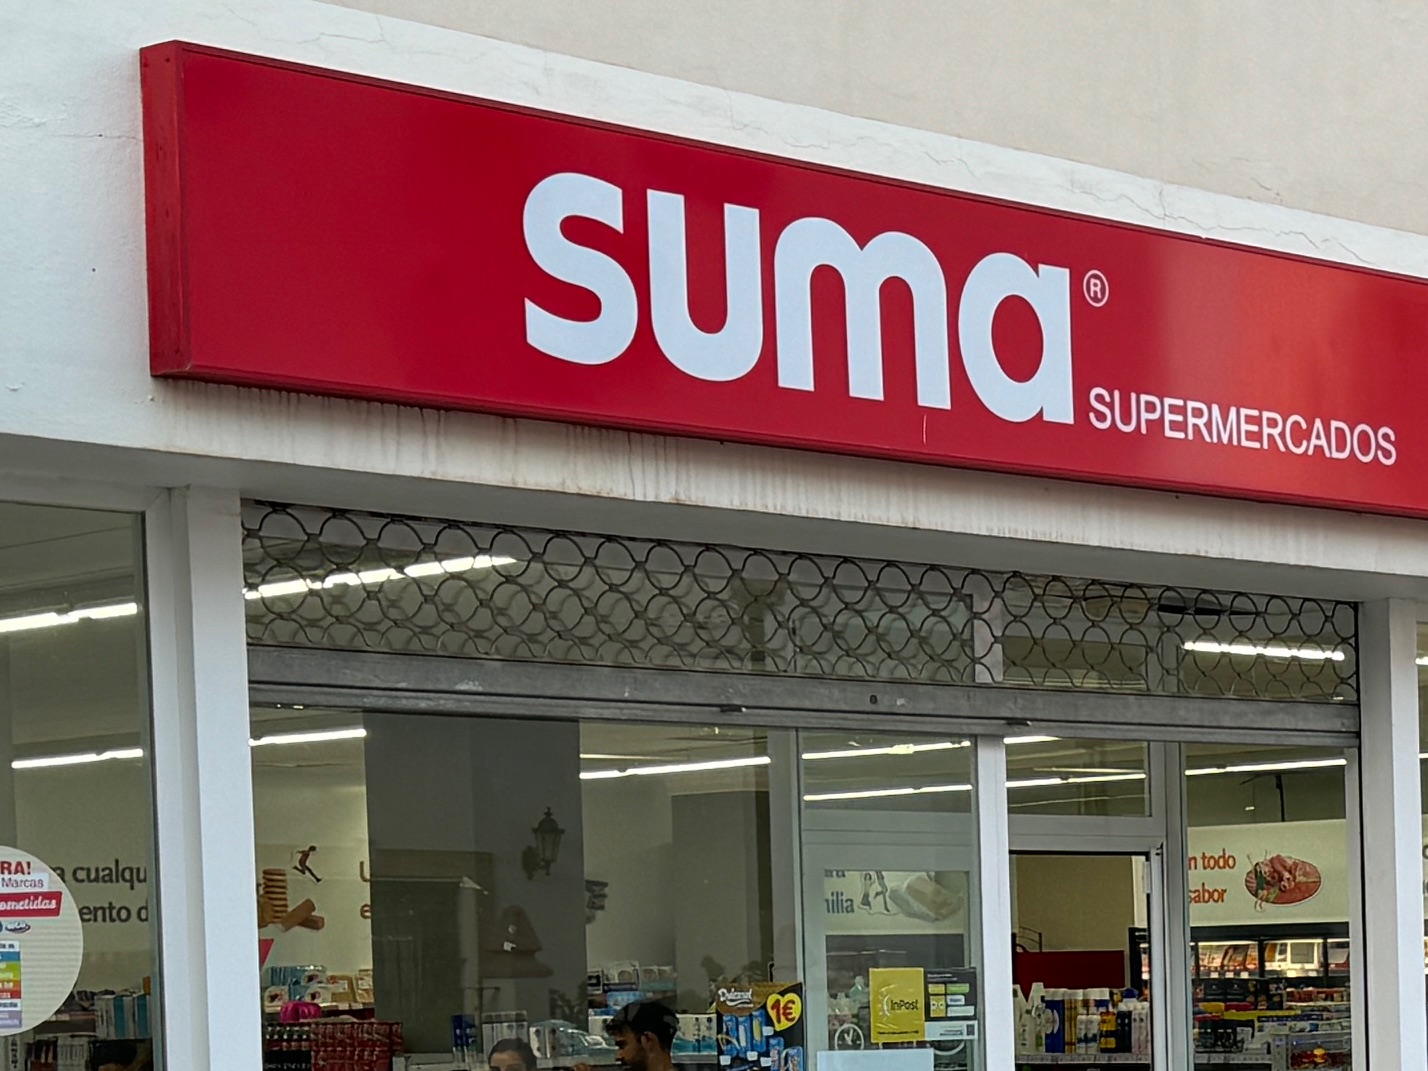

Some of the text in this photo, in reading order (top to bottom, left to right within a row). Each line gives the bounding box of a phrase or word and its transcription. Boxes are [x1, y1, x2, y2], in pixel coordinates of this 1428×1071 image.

[523, 172, 1074, 424] suma
[1089, 386, 1397, 466] SUPERMERCADOS
[1201, 848, 1236, 870] todo
[891, 1000, 918, 1011] InPost
